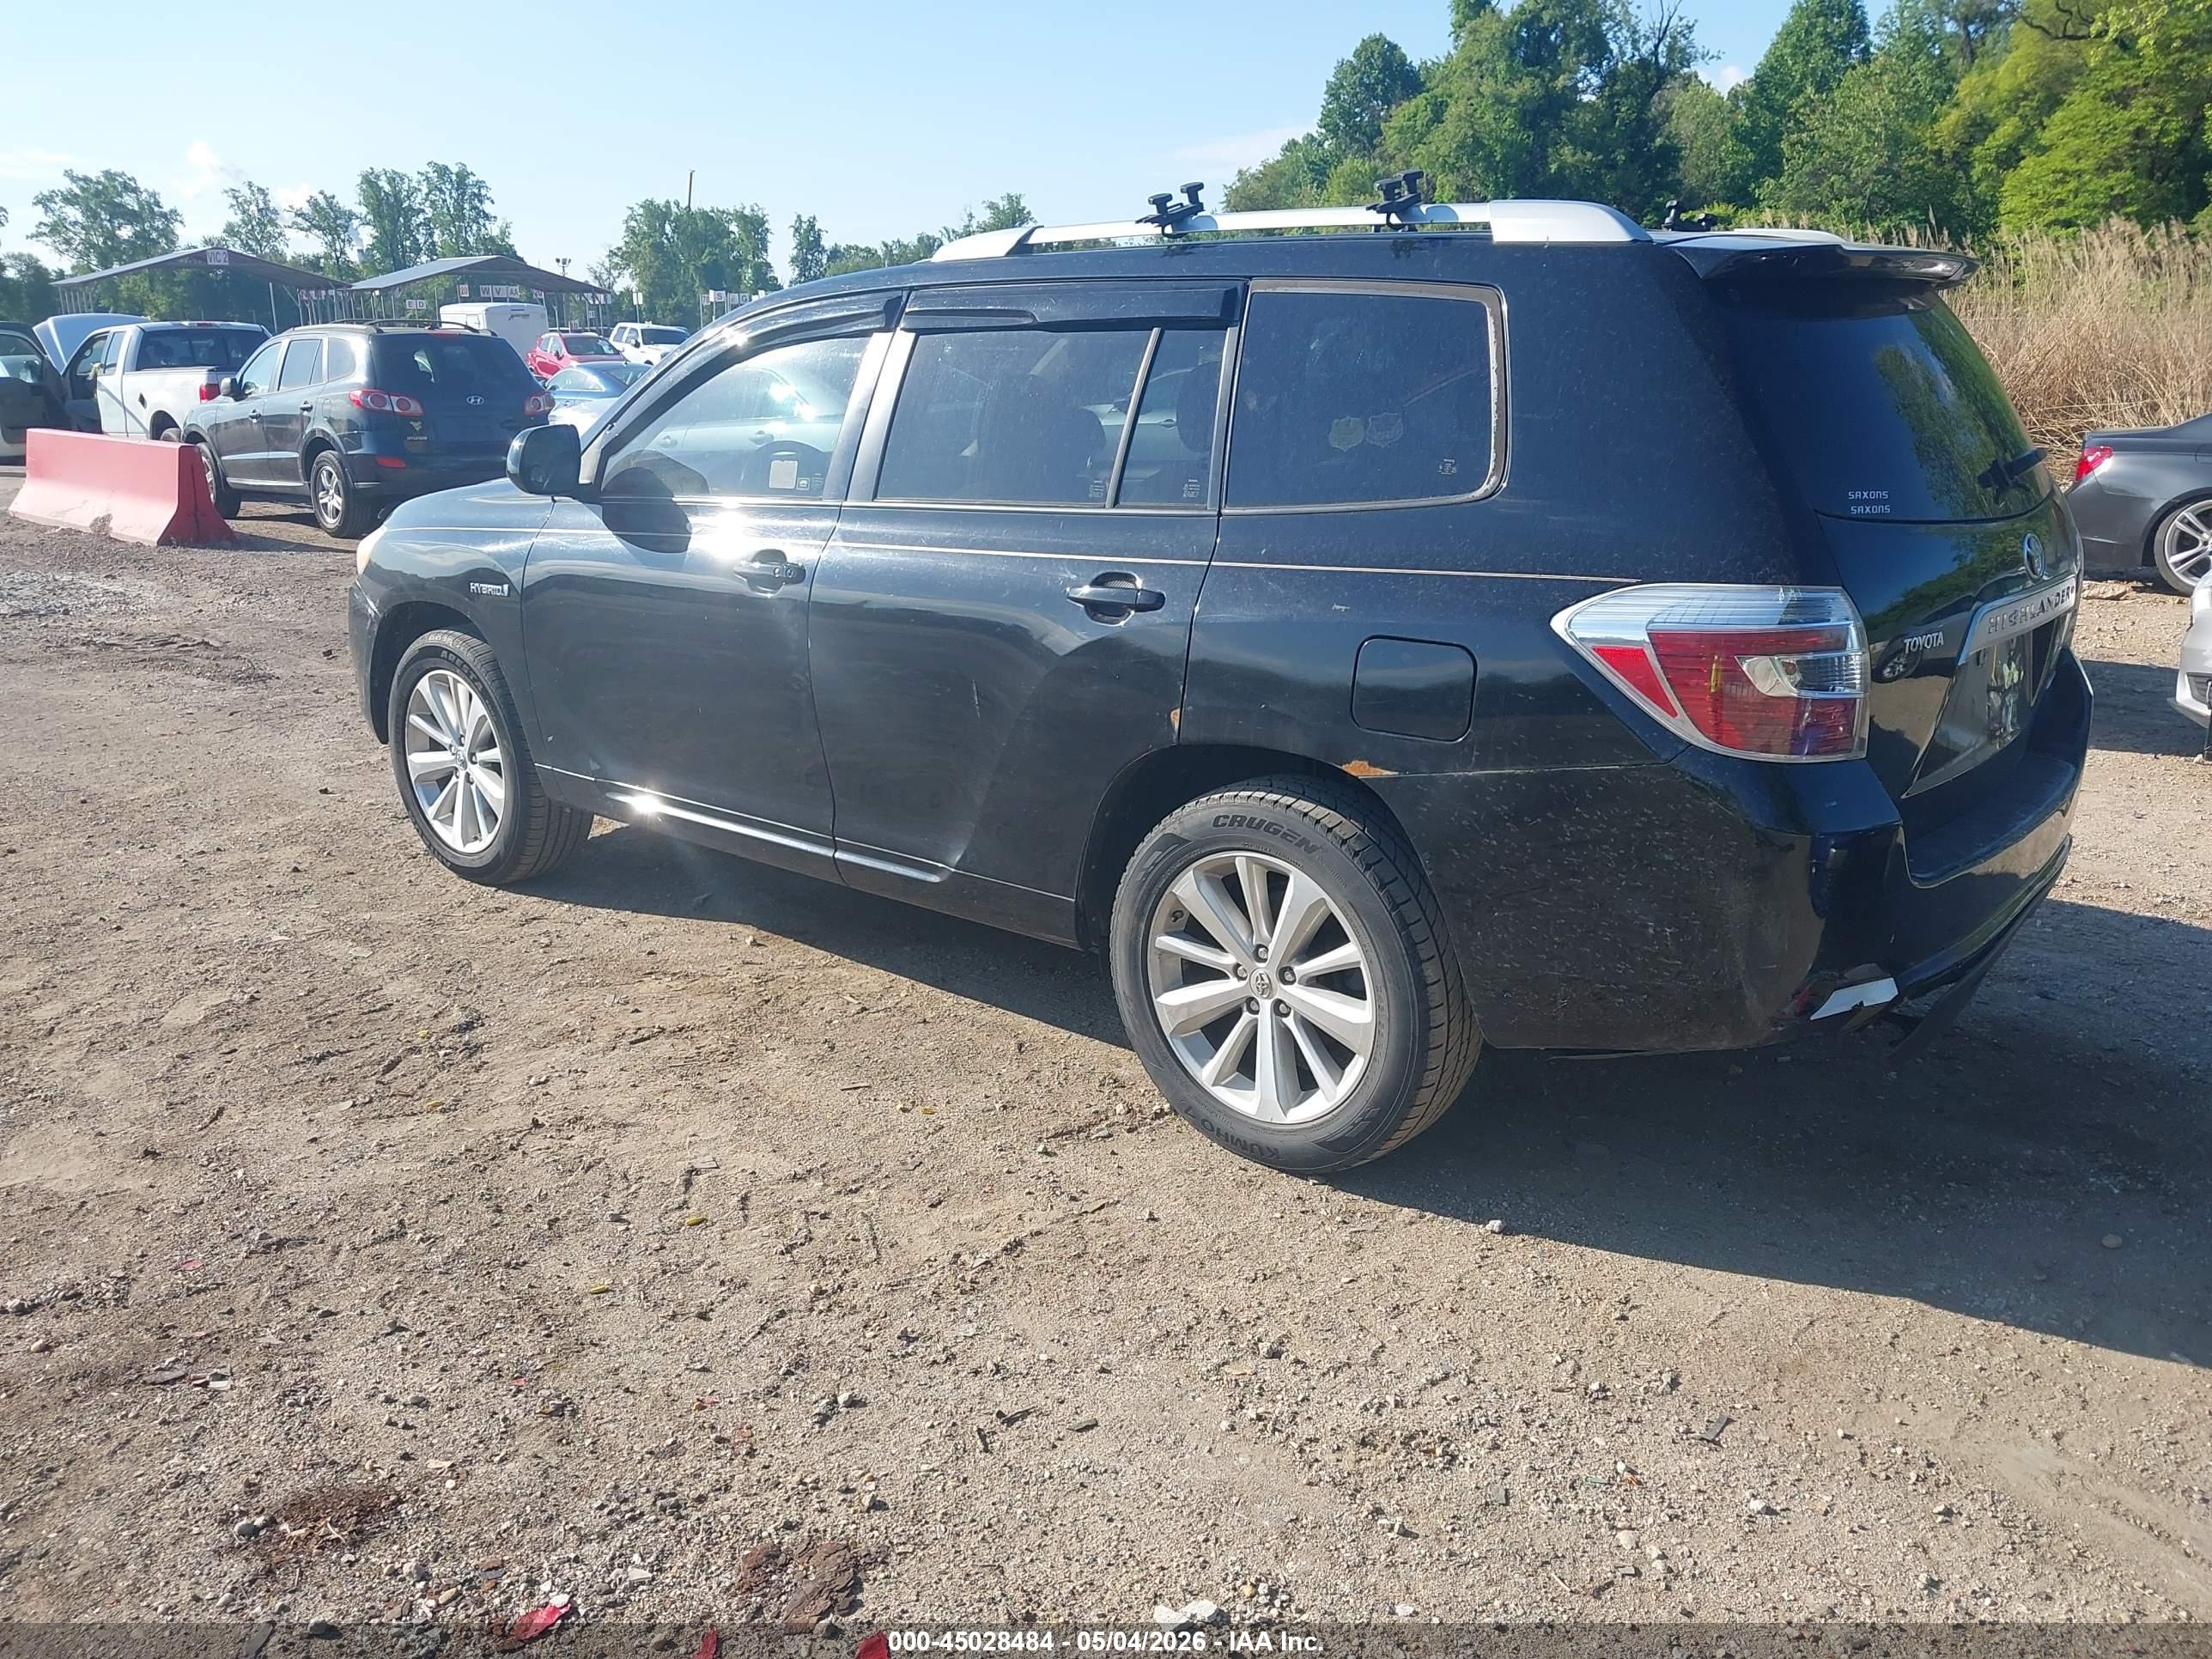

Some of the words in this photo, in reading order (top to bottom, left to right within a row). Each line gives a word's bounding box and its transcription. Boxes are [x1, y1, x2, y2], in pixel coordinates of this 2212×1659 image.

[207, 251, 221, 263] VIC
[222, 251, 228, 263] 2
[407, 300, 414, 308] E
[418, 300, 424, 308] D
[1848, 490, 1889, 500] SAXONS
[1850, 505, 1891, 514] SAXONS
[1988, 586, 2071, 635] HIGHLANDER
[1904, 631, 1945, 654] TOYOTA
[1212, 814, 1319, 855] CRUGEN
[1201, 1118, 1279, 1159] KUMHO
